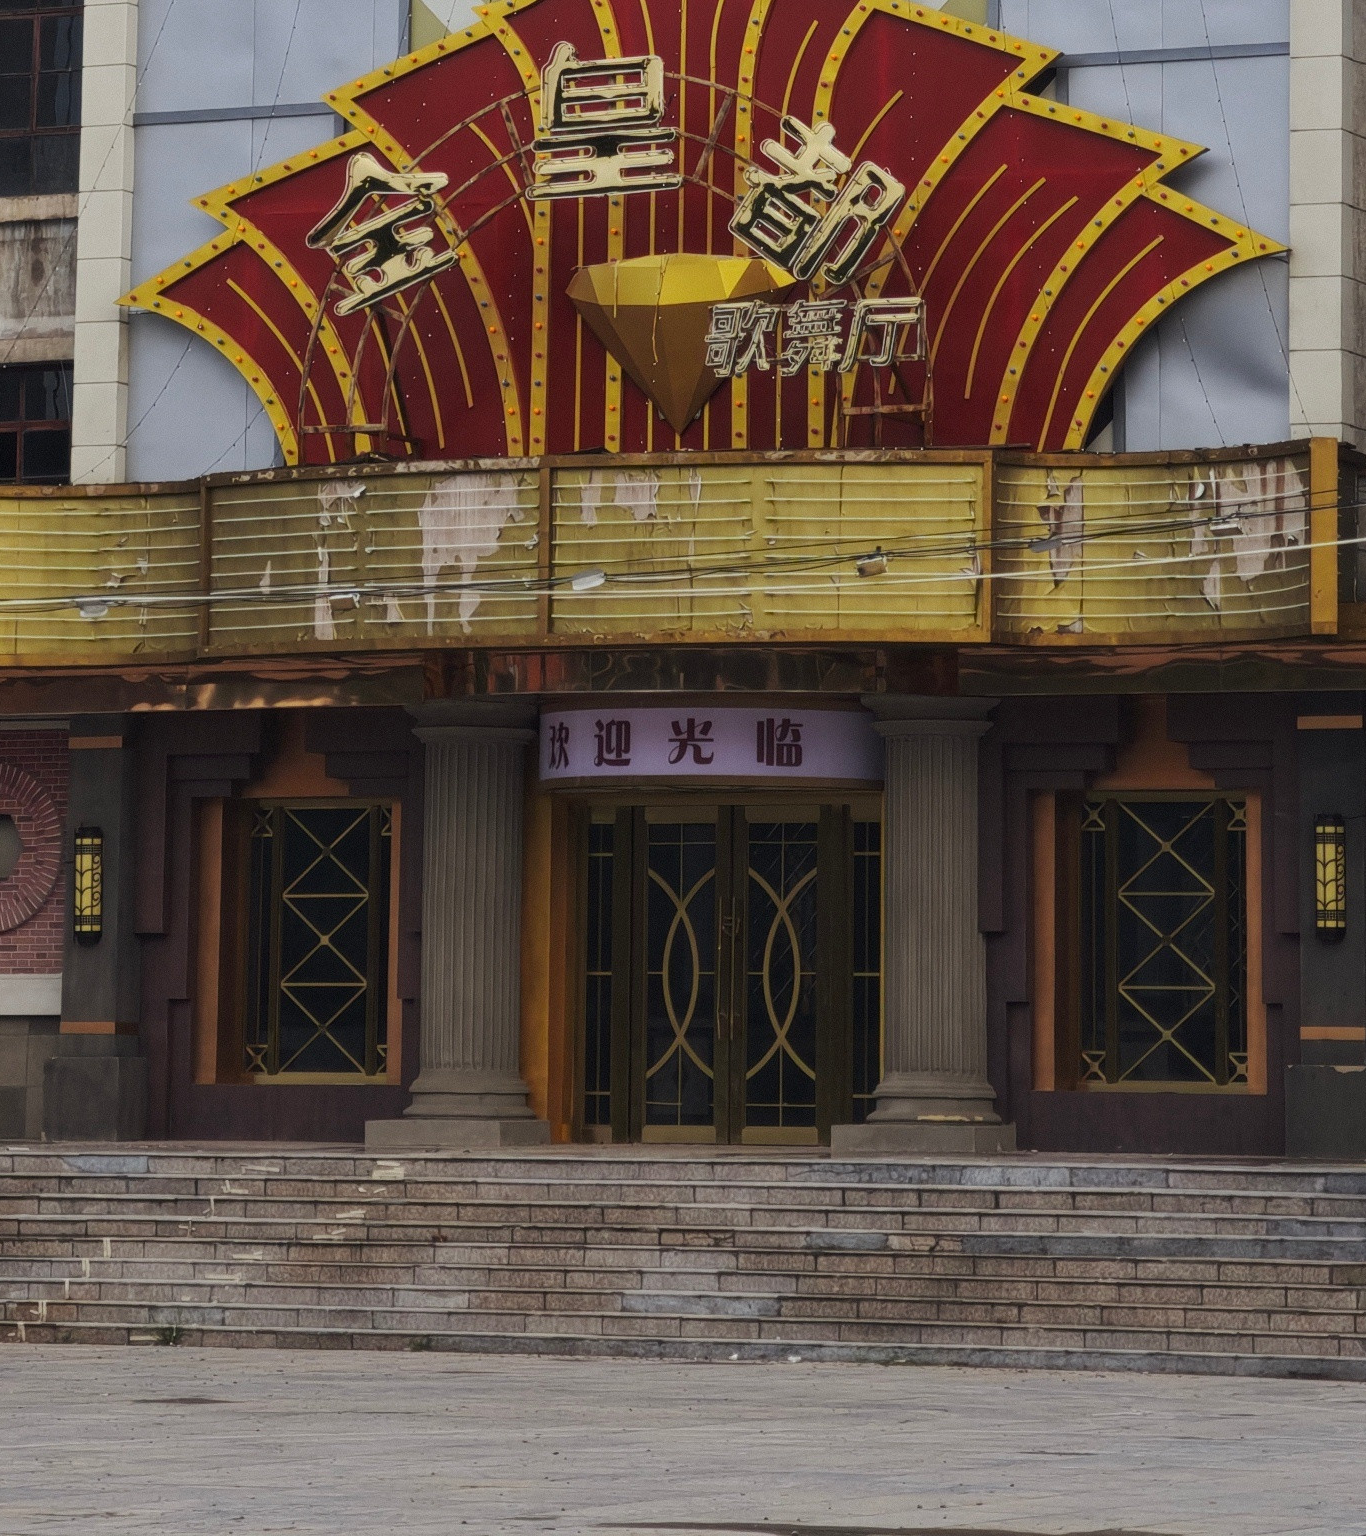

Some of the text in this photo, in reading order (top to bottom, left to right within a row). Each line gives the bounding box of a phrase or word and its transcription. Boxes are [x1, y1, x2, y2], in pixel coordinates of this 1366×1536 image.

[306, 40, 906, 316] 金皇都
[704, 297, 926, 376] 歌舞厅
[549, 717, 804, 770] 欢迎光临
